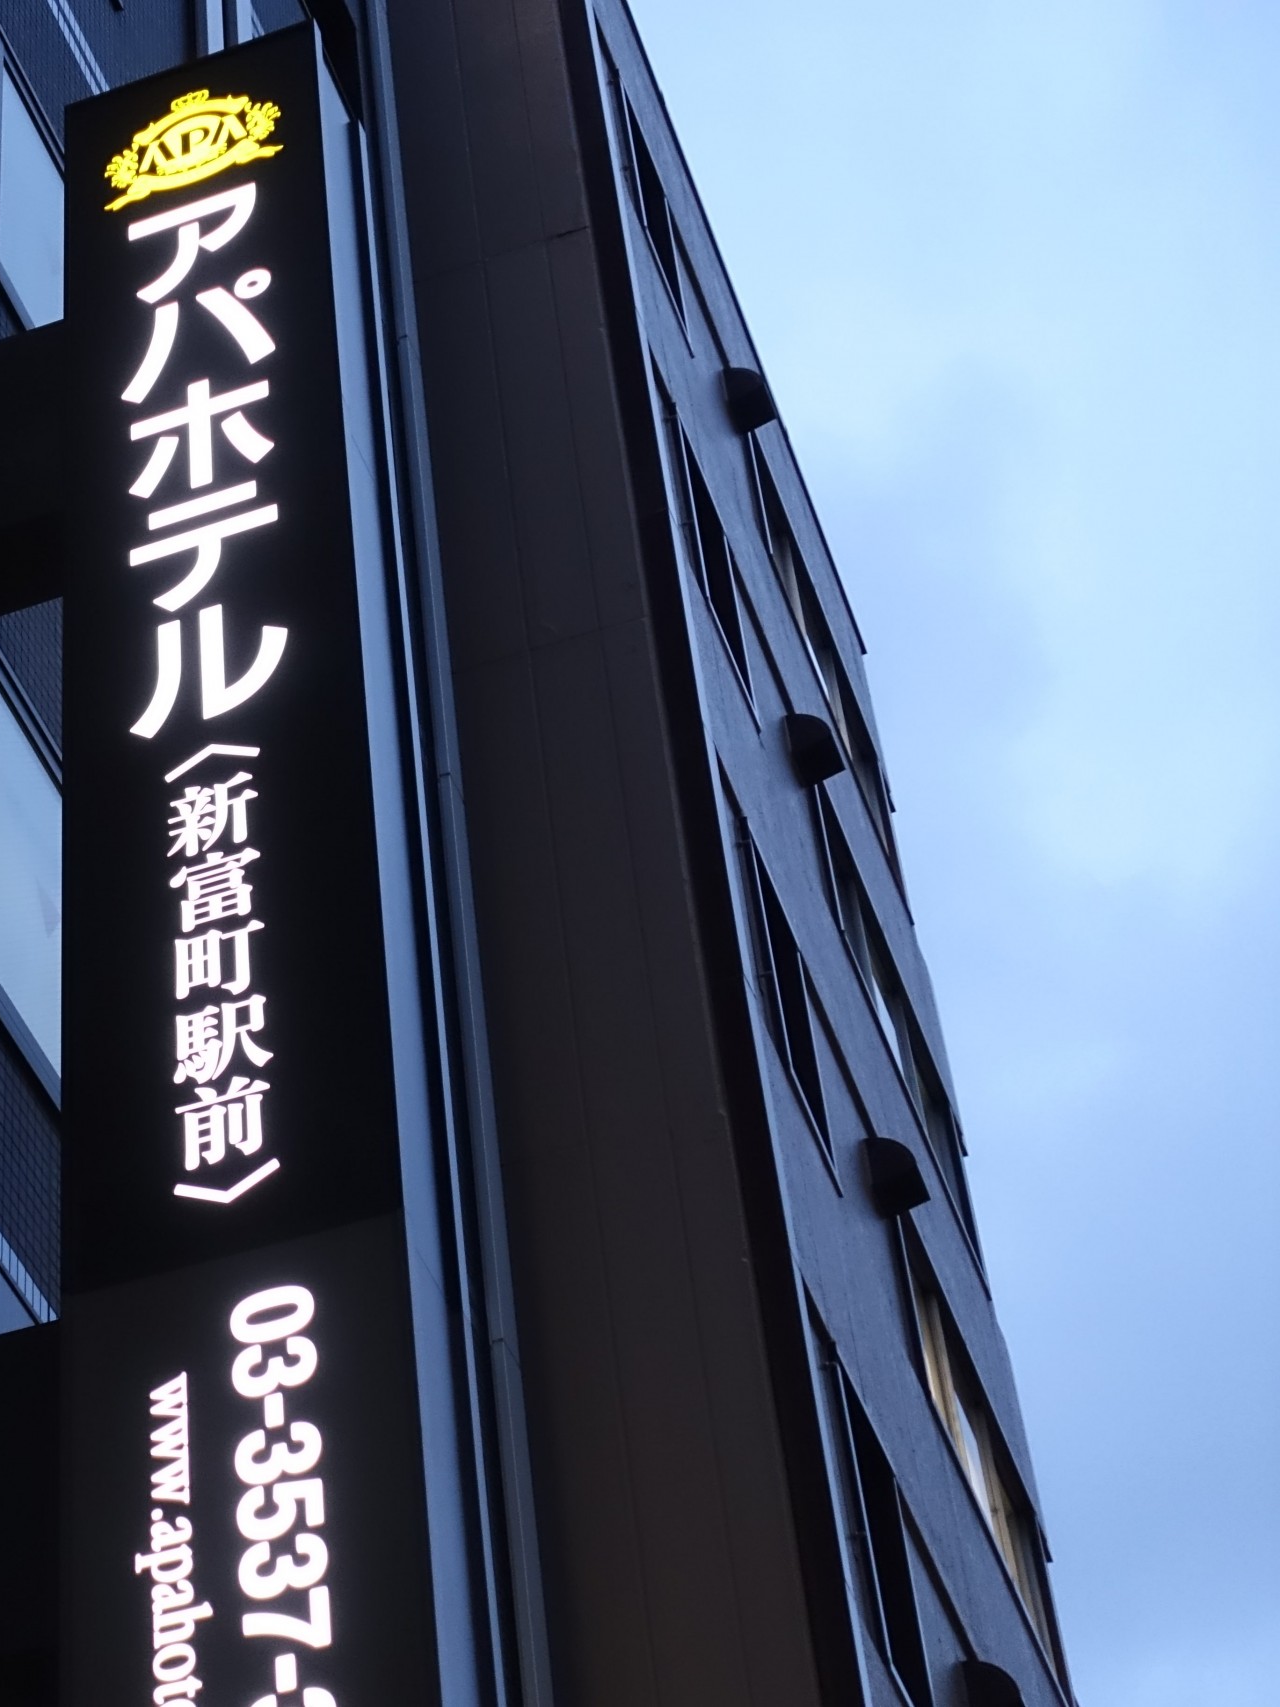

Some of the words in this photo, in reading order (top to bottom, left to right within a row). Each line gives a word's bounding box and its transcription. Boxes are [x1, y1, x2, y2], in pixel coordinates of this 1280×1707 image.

[138, 113, 248, 174] APA
[121, 182, 289, 740] アパホテル
[134, 1371, 214, 1707] www.apahot
[229, 1285, 337, 1707] 03-3537-
